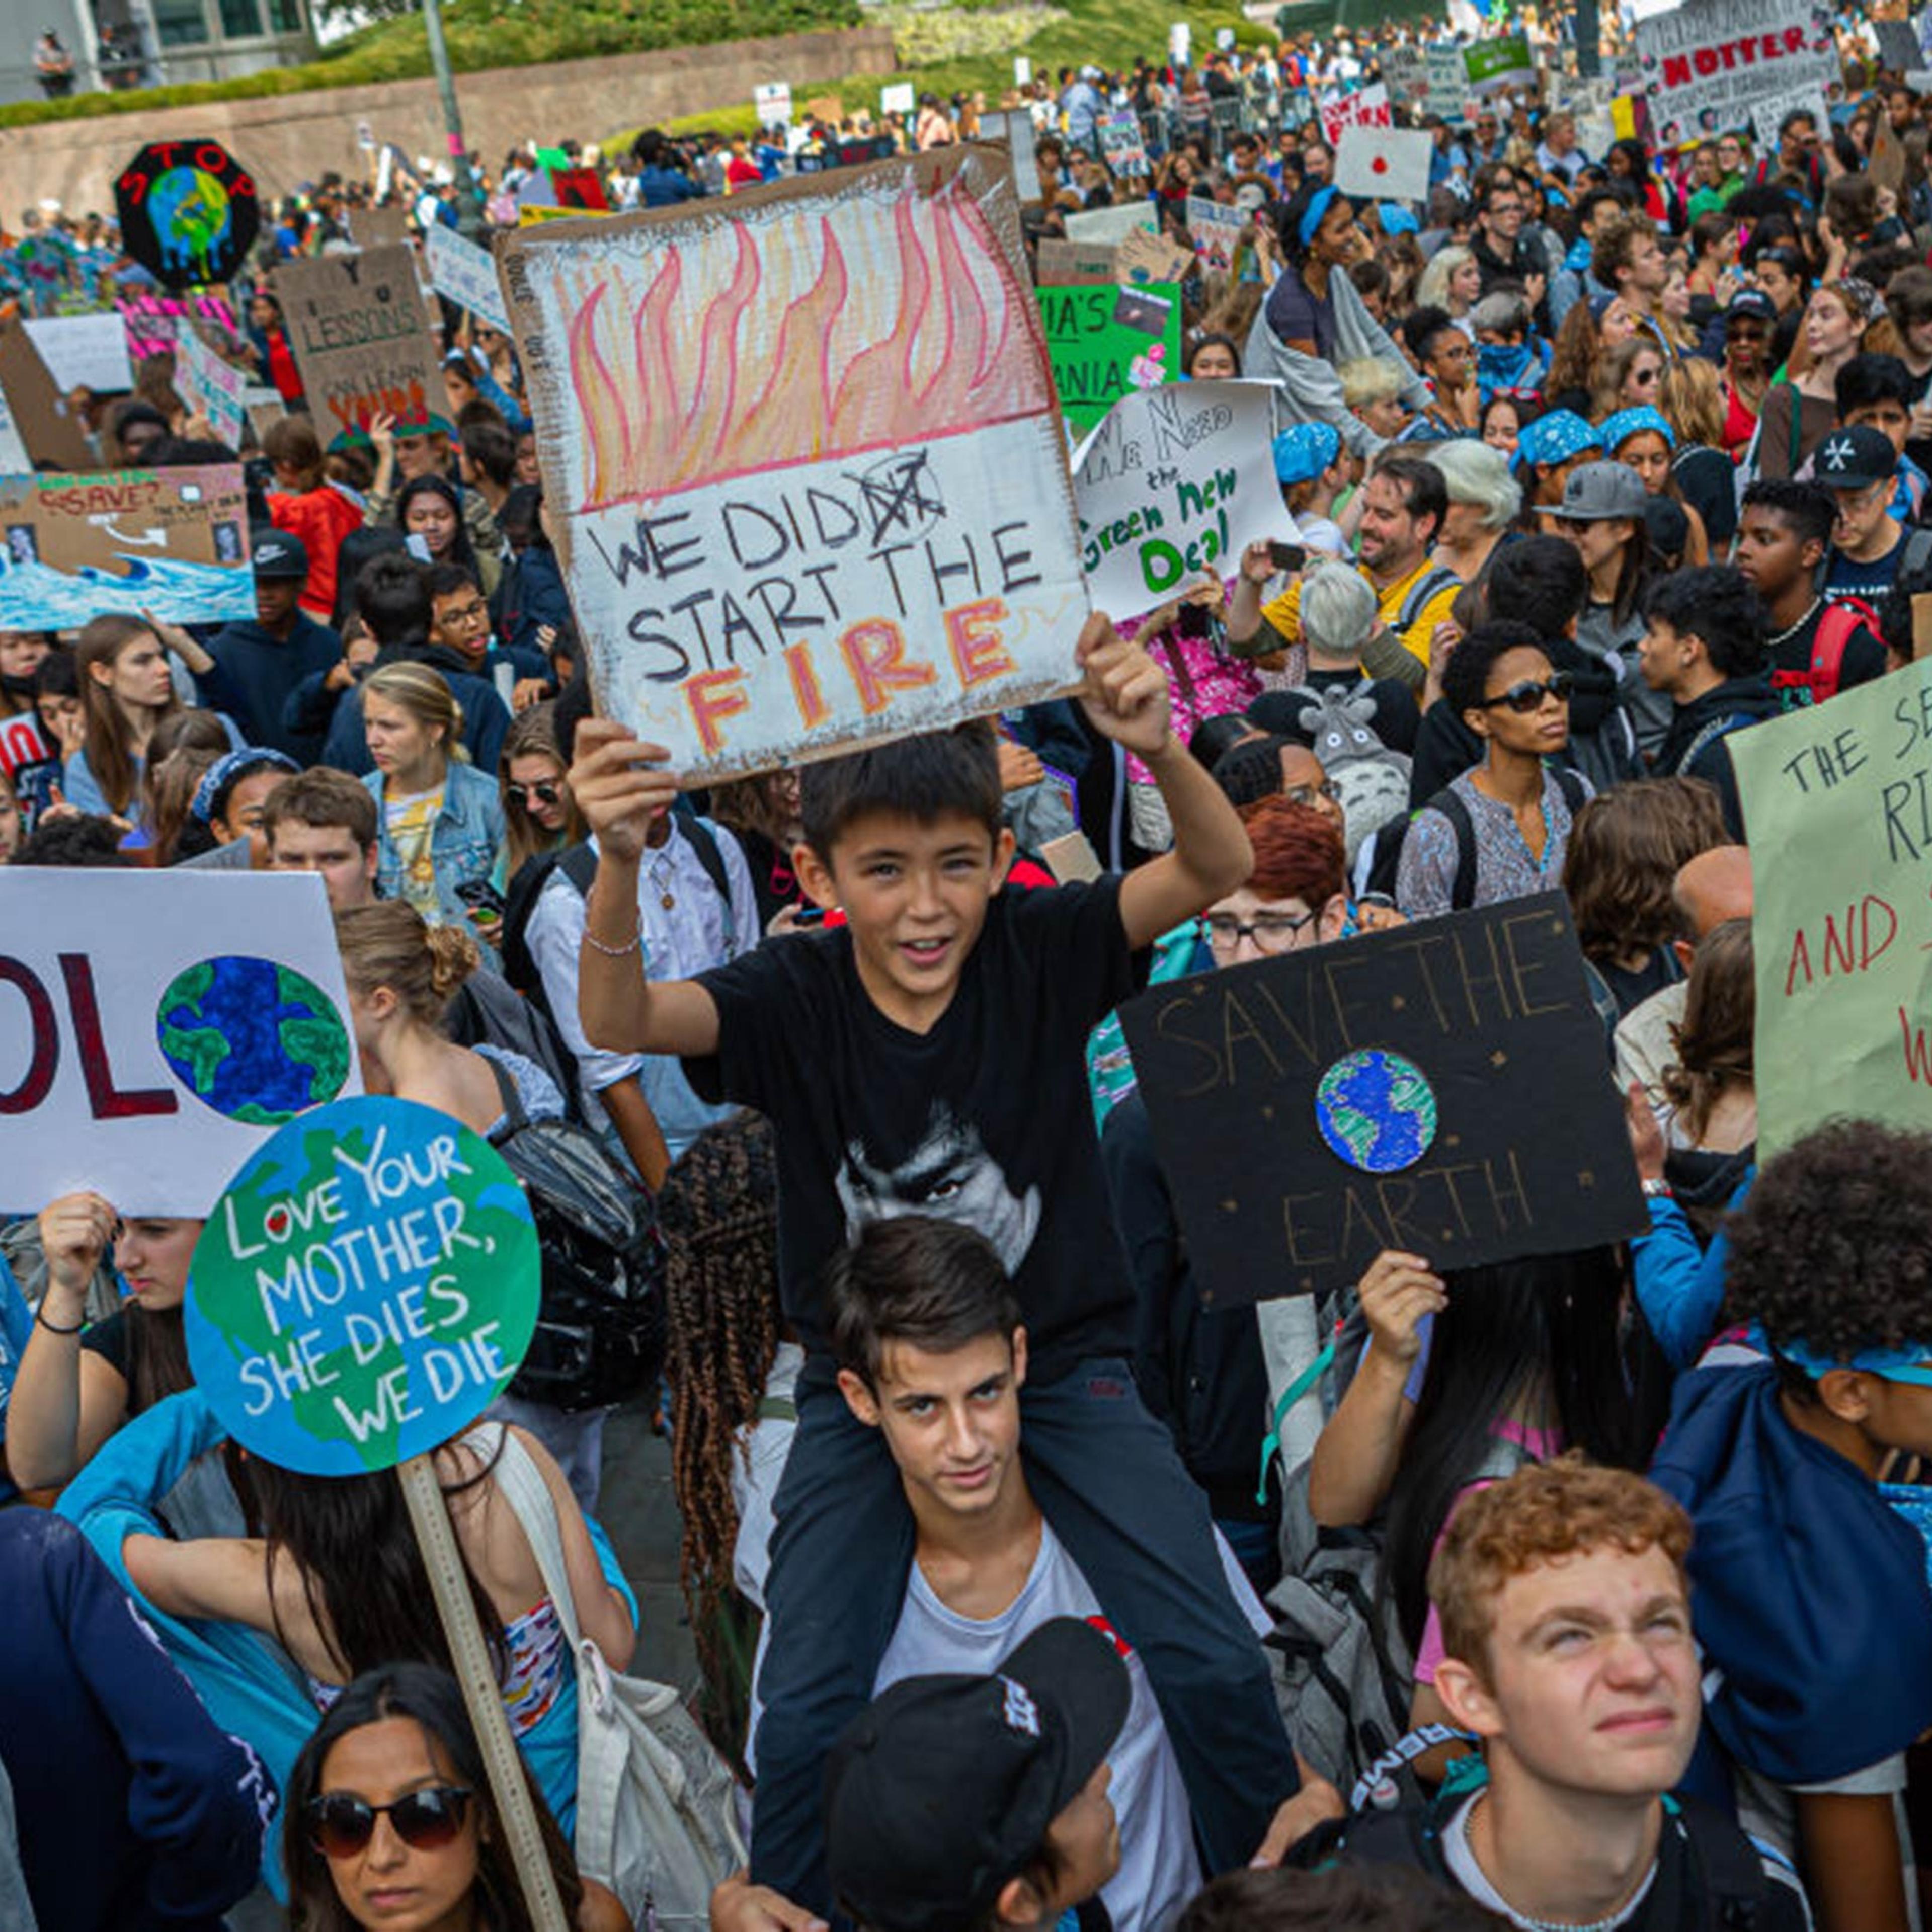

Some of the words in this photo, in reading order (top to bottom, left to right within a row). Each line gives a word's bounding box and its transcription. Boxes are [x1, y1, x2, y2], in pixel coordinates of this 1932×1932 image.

[120, 141, 256, 205] STOP
[1040, 292, 1107, 333] IA'S
[586, 511, 705, 587] WE
[627, 563, 841, 681] START
[868, 522, 1041, 617] THE
[679, 596, 1019, 756] FIRE
[1782, 728, 1869, 793] THE
[1386, 909, 1570, 1033] THE
[1785, 893, 1898, 997] AND
[224, 1182, 344, 1260] LOVE
[332, 1125, 472, 1206] YOUR
[1283, 1150, 1533, 1266] EARTH
[255, 1196, 496, 1336] MOTHER,
[238, 1328, 340, 1418] SHE
[345, 1274, 469, 1367] DIES
[332, 1372, 424, 1443] WE
[423, 1321, 518, 1405] DIE
